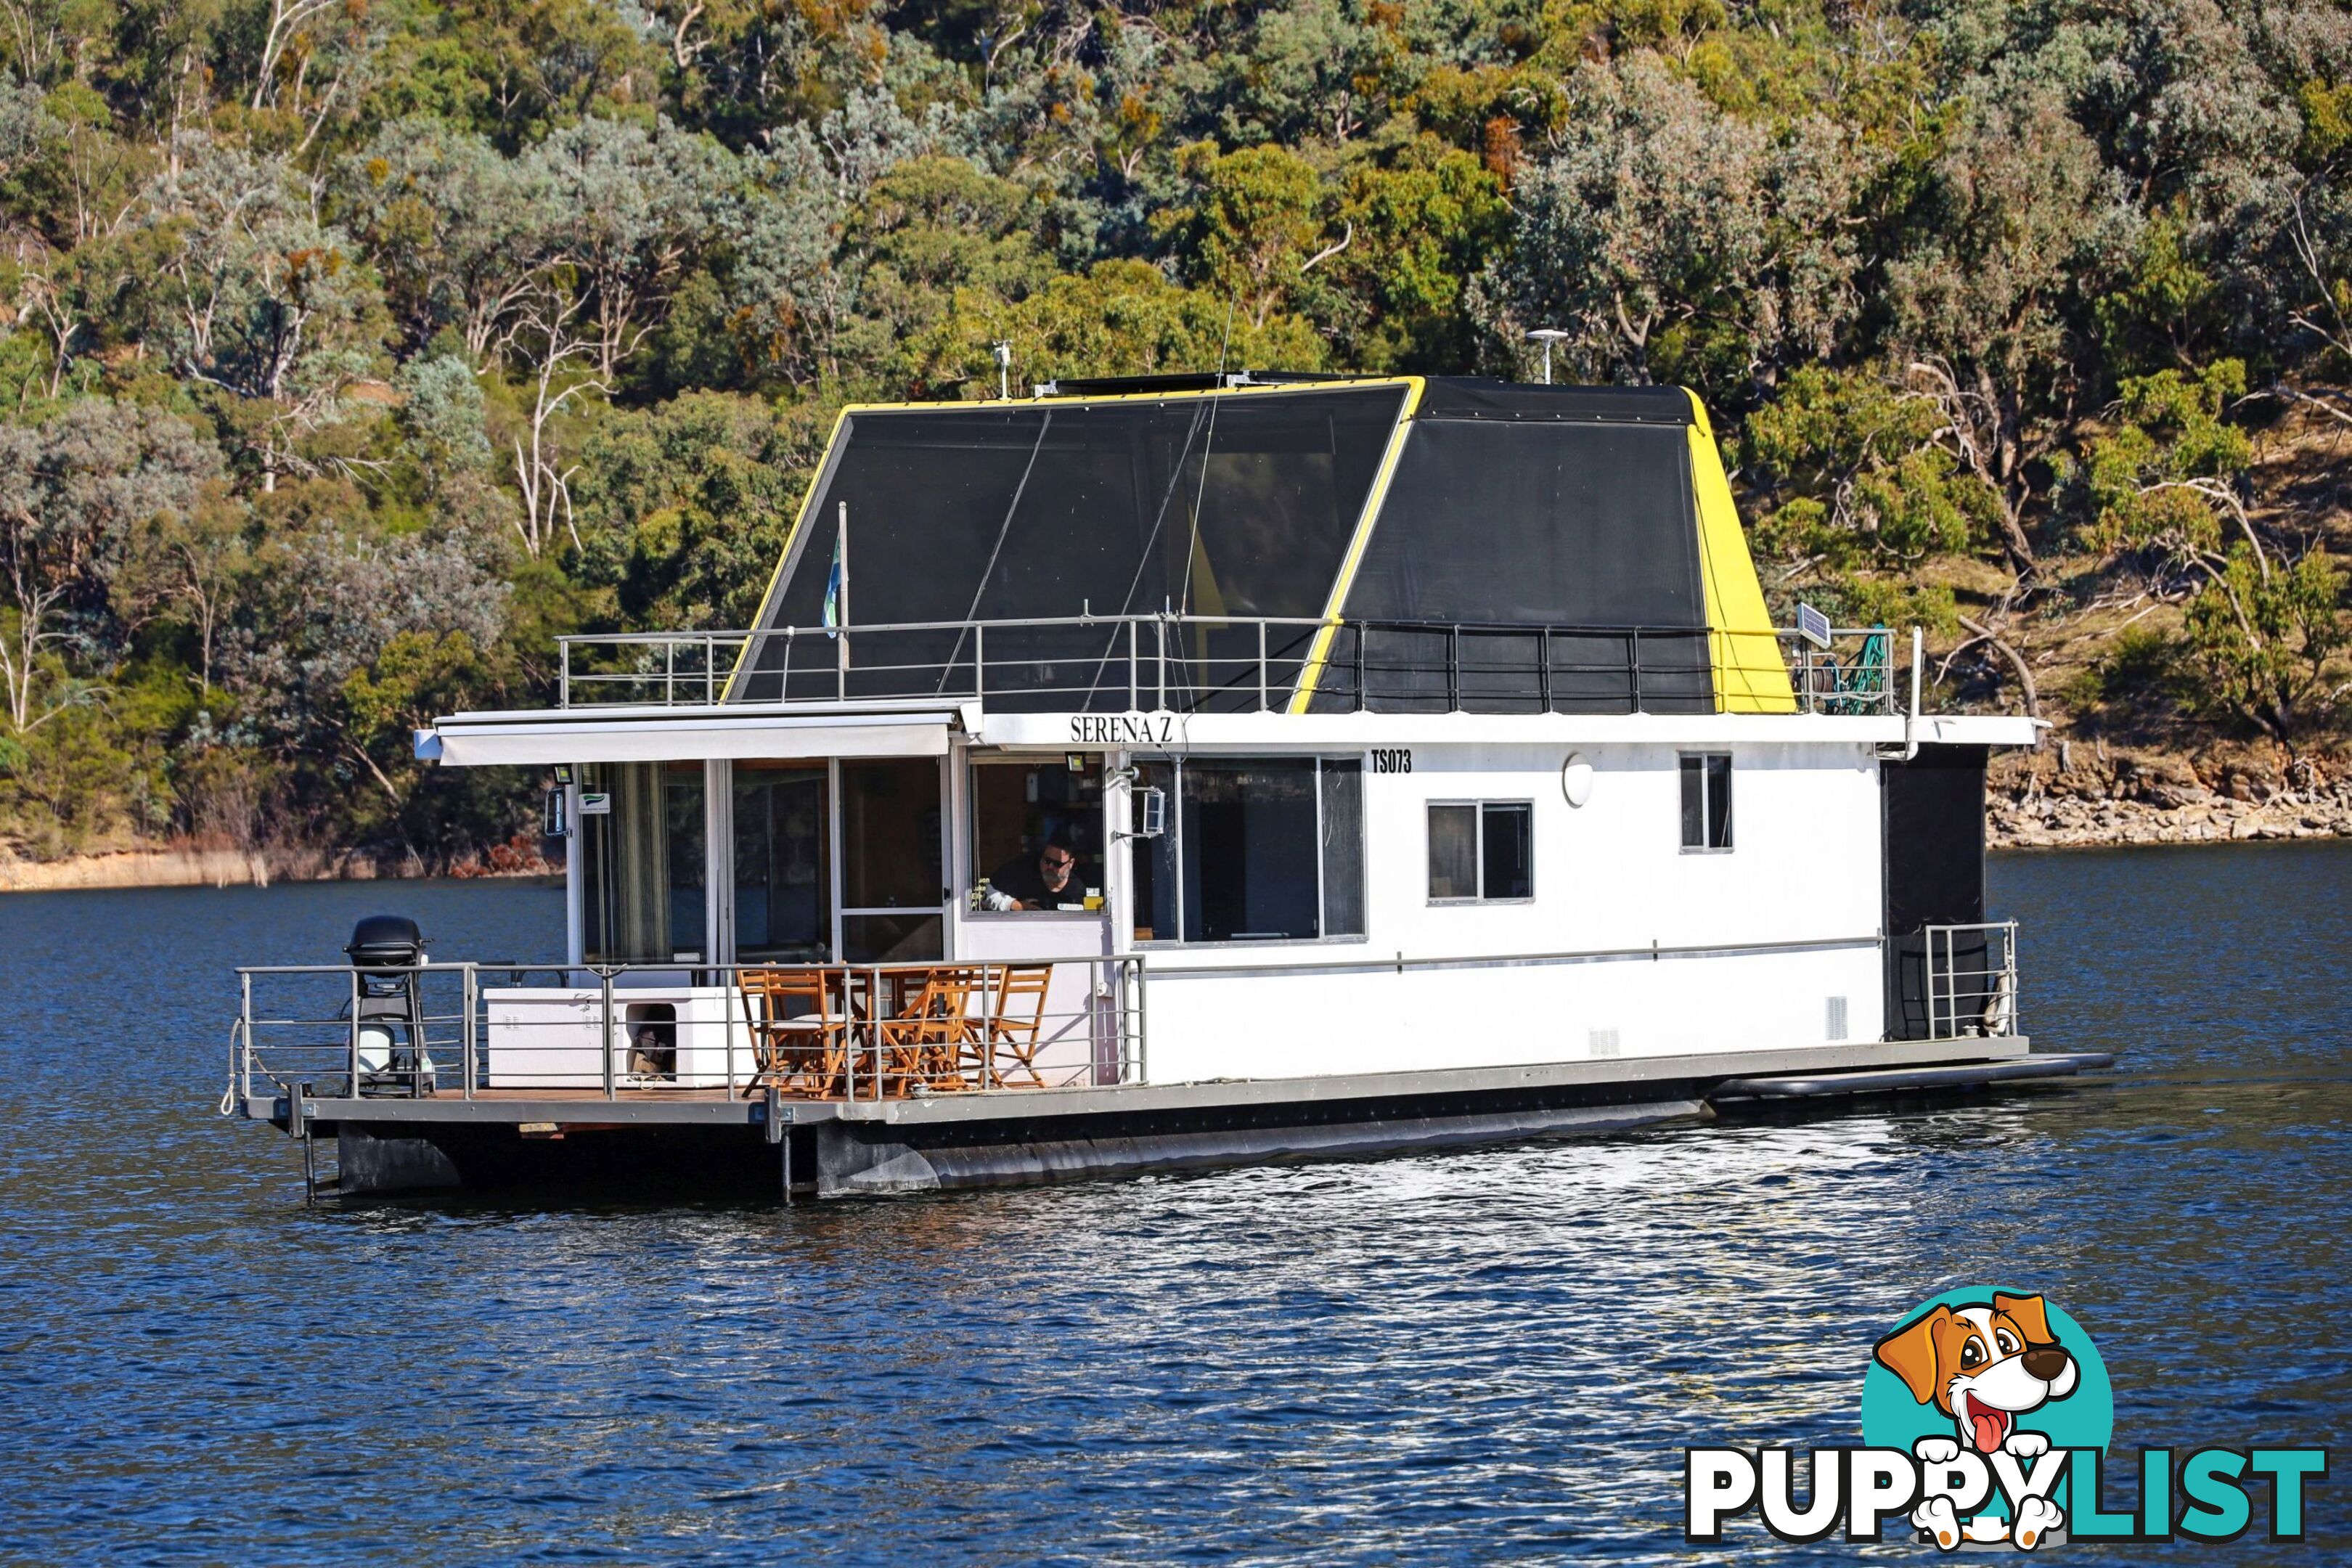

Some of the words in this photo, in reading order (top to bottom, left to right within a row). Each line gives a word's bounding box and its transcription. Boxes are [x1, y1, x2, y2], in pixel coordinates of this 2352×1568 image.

[1071, 716, 1153, 742] SERENA
[1160, 716, 1172, 742] Z
[1371, 748, 1412, 774] TS073
